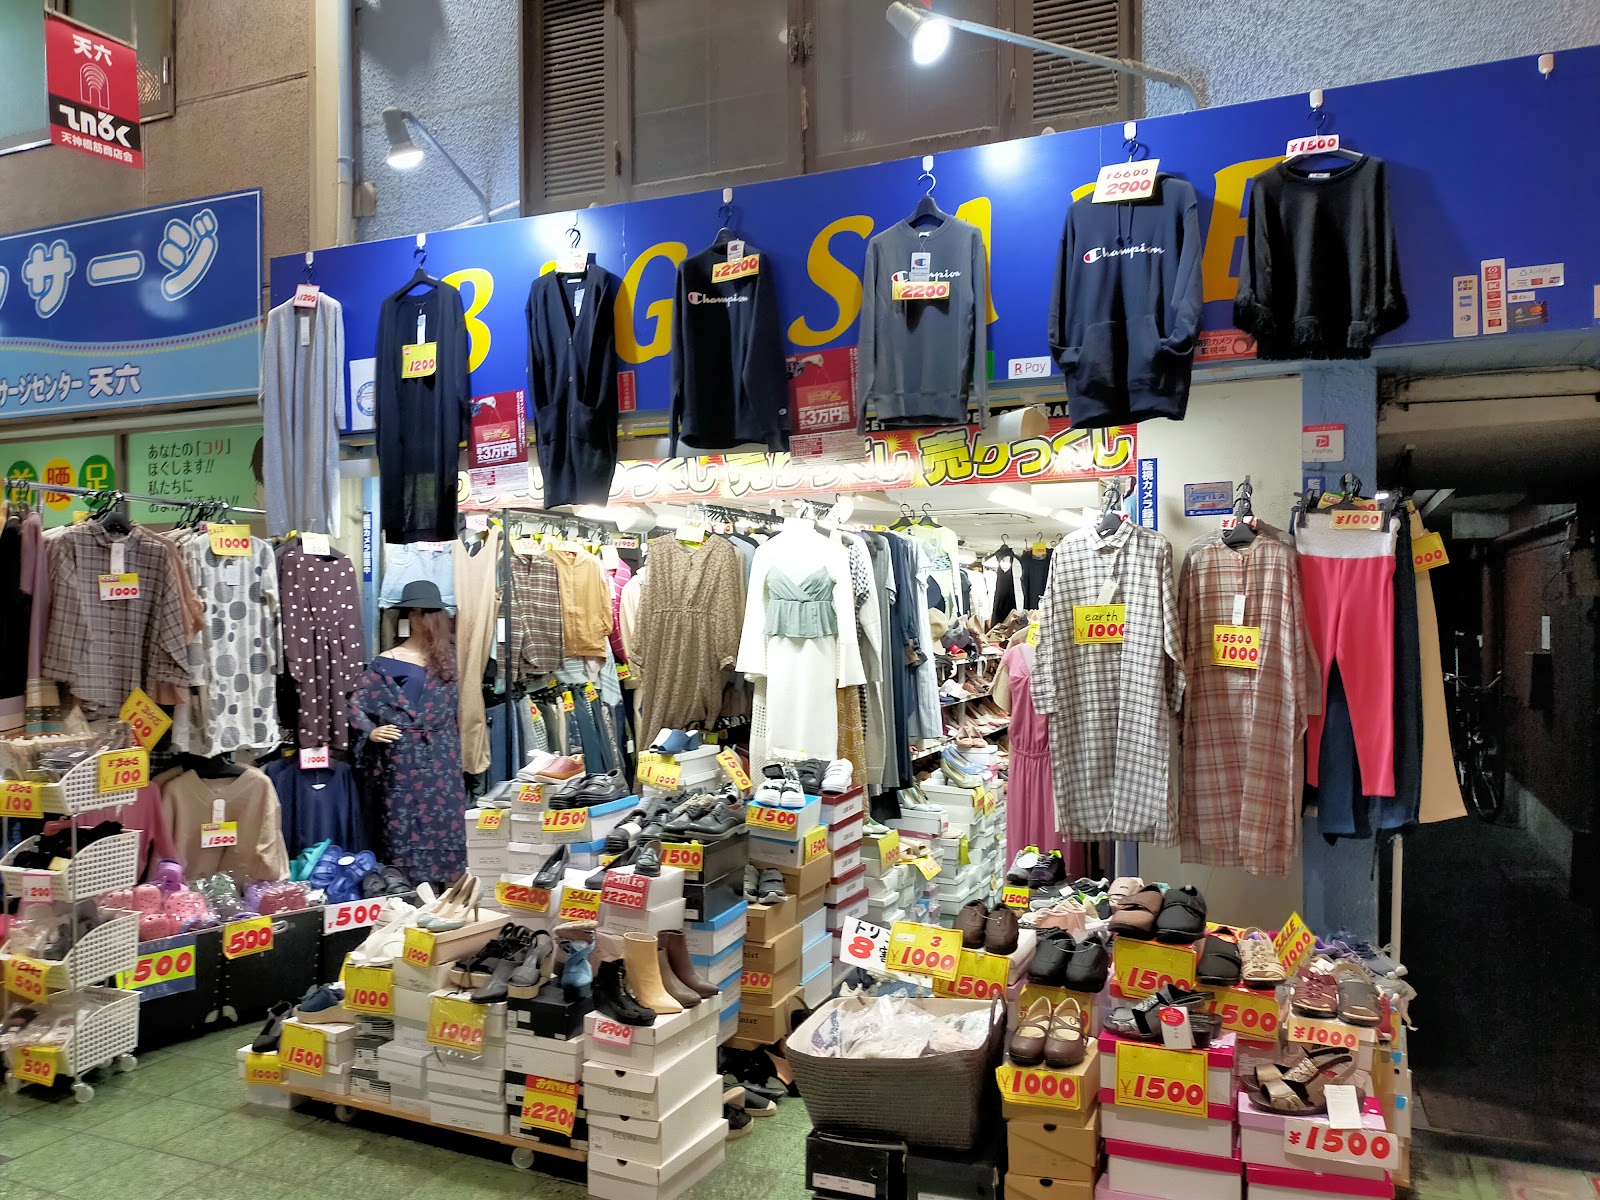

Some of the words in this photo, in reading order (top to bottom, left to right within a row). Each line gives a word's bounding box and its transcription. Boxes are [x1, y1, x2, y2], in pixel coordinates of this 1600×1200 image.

[72, 33, 112, 66] 天六
[1105, 180, 1151, 196] 2900
[1084, 243, 1164, 264] Champion
[0, 208, 218, 319] サージ
[714, 259, 759, 279] ¥2200
[688, 291, 749, 307] Champion
[1025, 362, 1047, 373] Pay
[88, 363, 142, 398] 天六
[148, 438, 231, 459] あなたの「コリ」
[916, 426, 1132, 487] 売りつくし
[46, 466, 71, 503] 腰
[148, 479, 193, 495] 私たちに
[1336, 514, 1379, 525] ¥1000
[1085, 612, 1118, 622] earth
[1216, 633, 1252, 645] ¥5500
[113, 769, 141, 785] 100
[5, 795, 33, 812] 100
[518, 792, 542, 803] 1500
[544, 811, 587, 826] ¥1500
[568, 889, 596, 902] SALE
[602, 890, 642, 907] ¥2200
[560, 906, 597, 921] ¥2200
[930, 936, 943, 948] 3
[1275, 919, 1295, 951] SALE
[1293, 1025, 1357, 1048] ¥1000
[24, 1059, 50, 1077] 500
[1001, 1070, 1076, 1099] ¥1000
[1120, 1075, 1204, 1106] ¥1500
[1288, 1126, 1391, 1160] ¥1500
